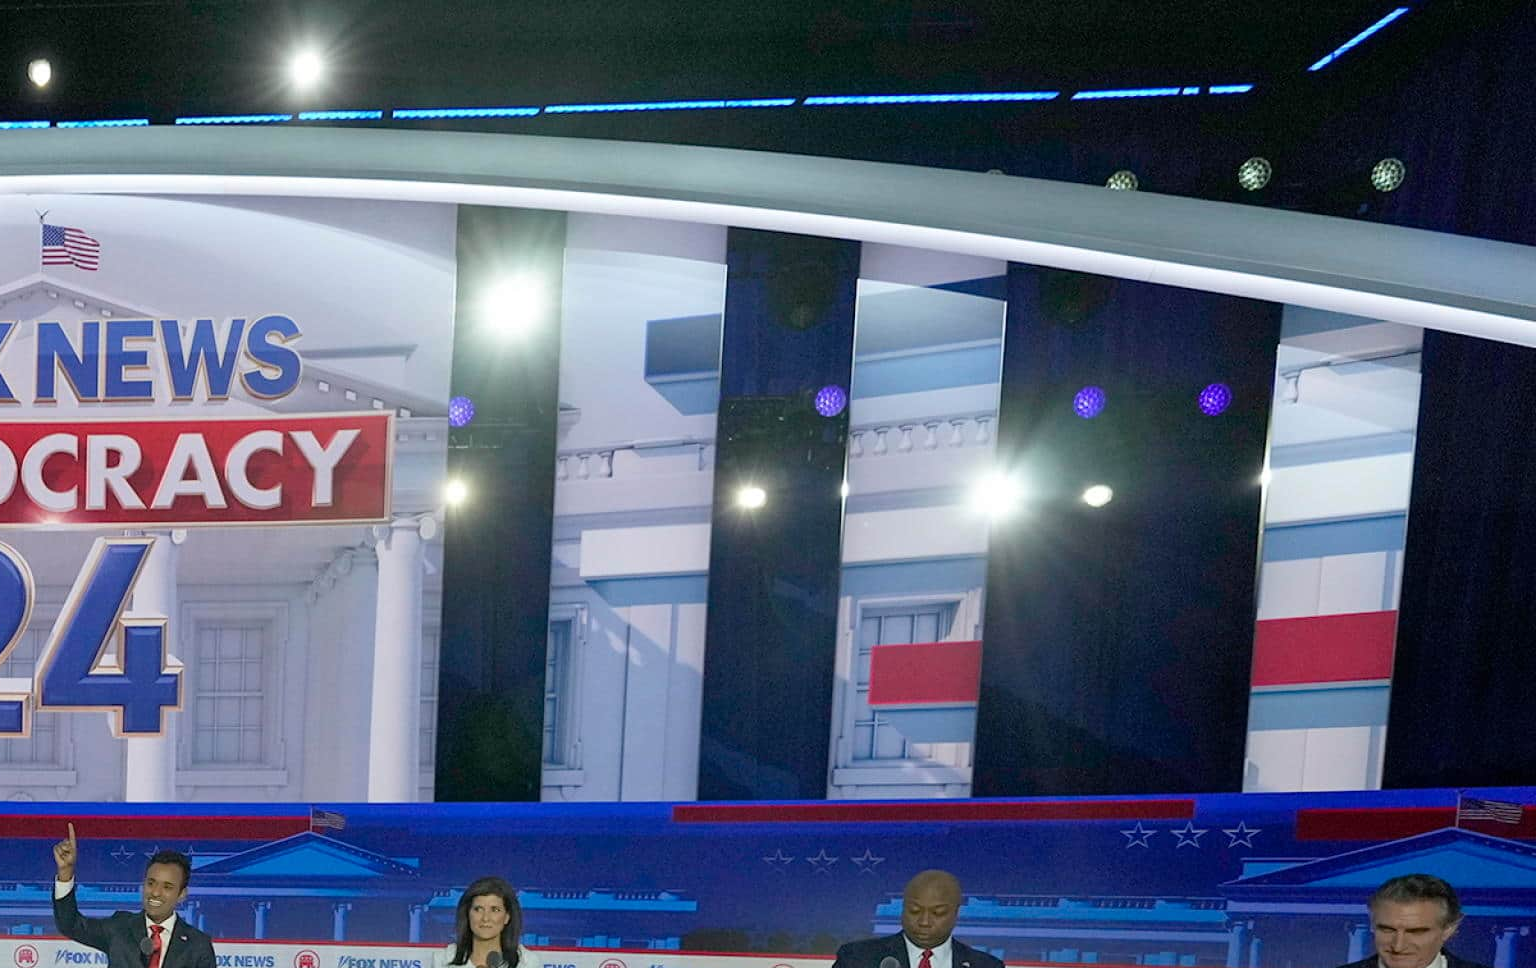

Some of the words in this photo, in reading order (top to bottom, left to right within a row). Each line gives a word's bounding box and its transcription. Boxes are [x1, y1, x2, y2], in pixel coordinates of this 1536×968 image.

[33, 313, 303, 404] NEWS
[65, 952, 91, 963] FOX
[216, 955, 232, 967] OX
[235, 956, 274, 968] NEWS
